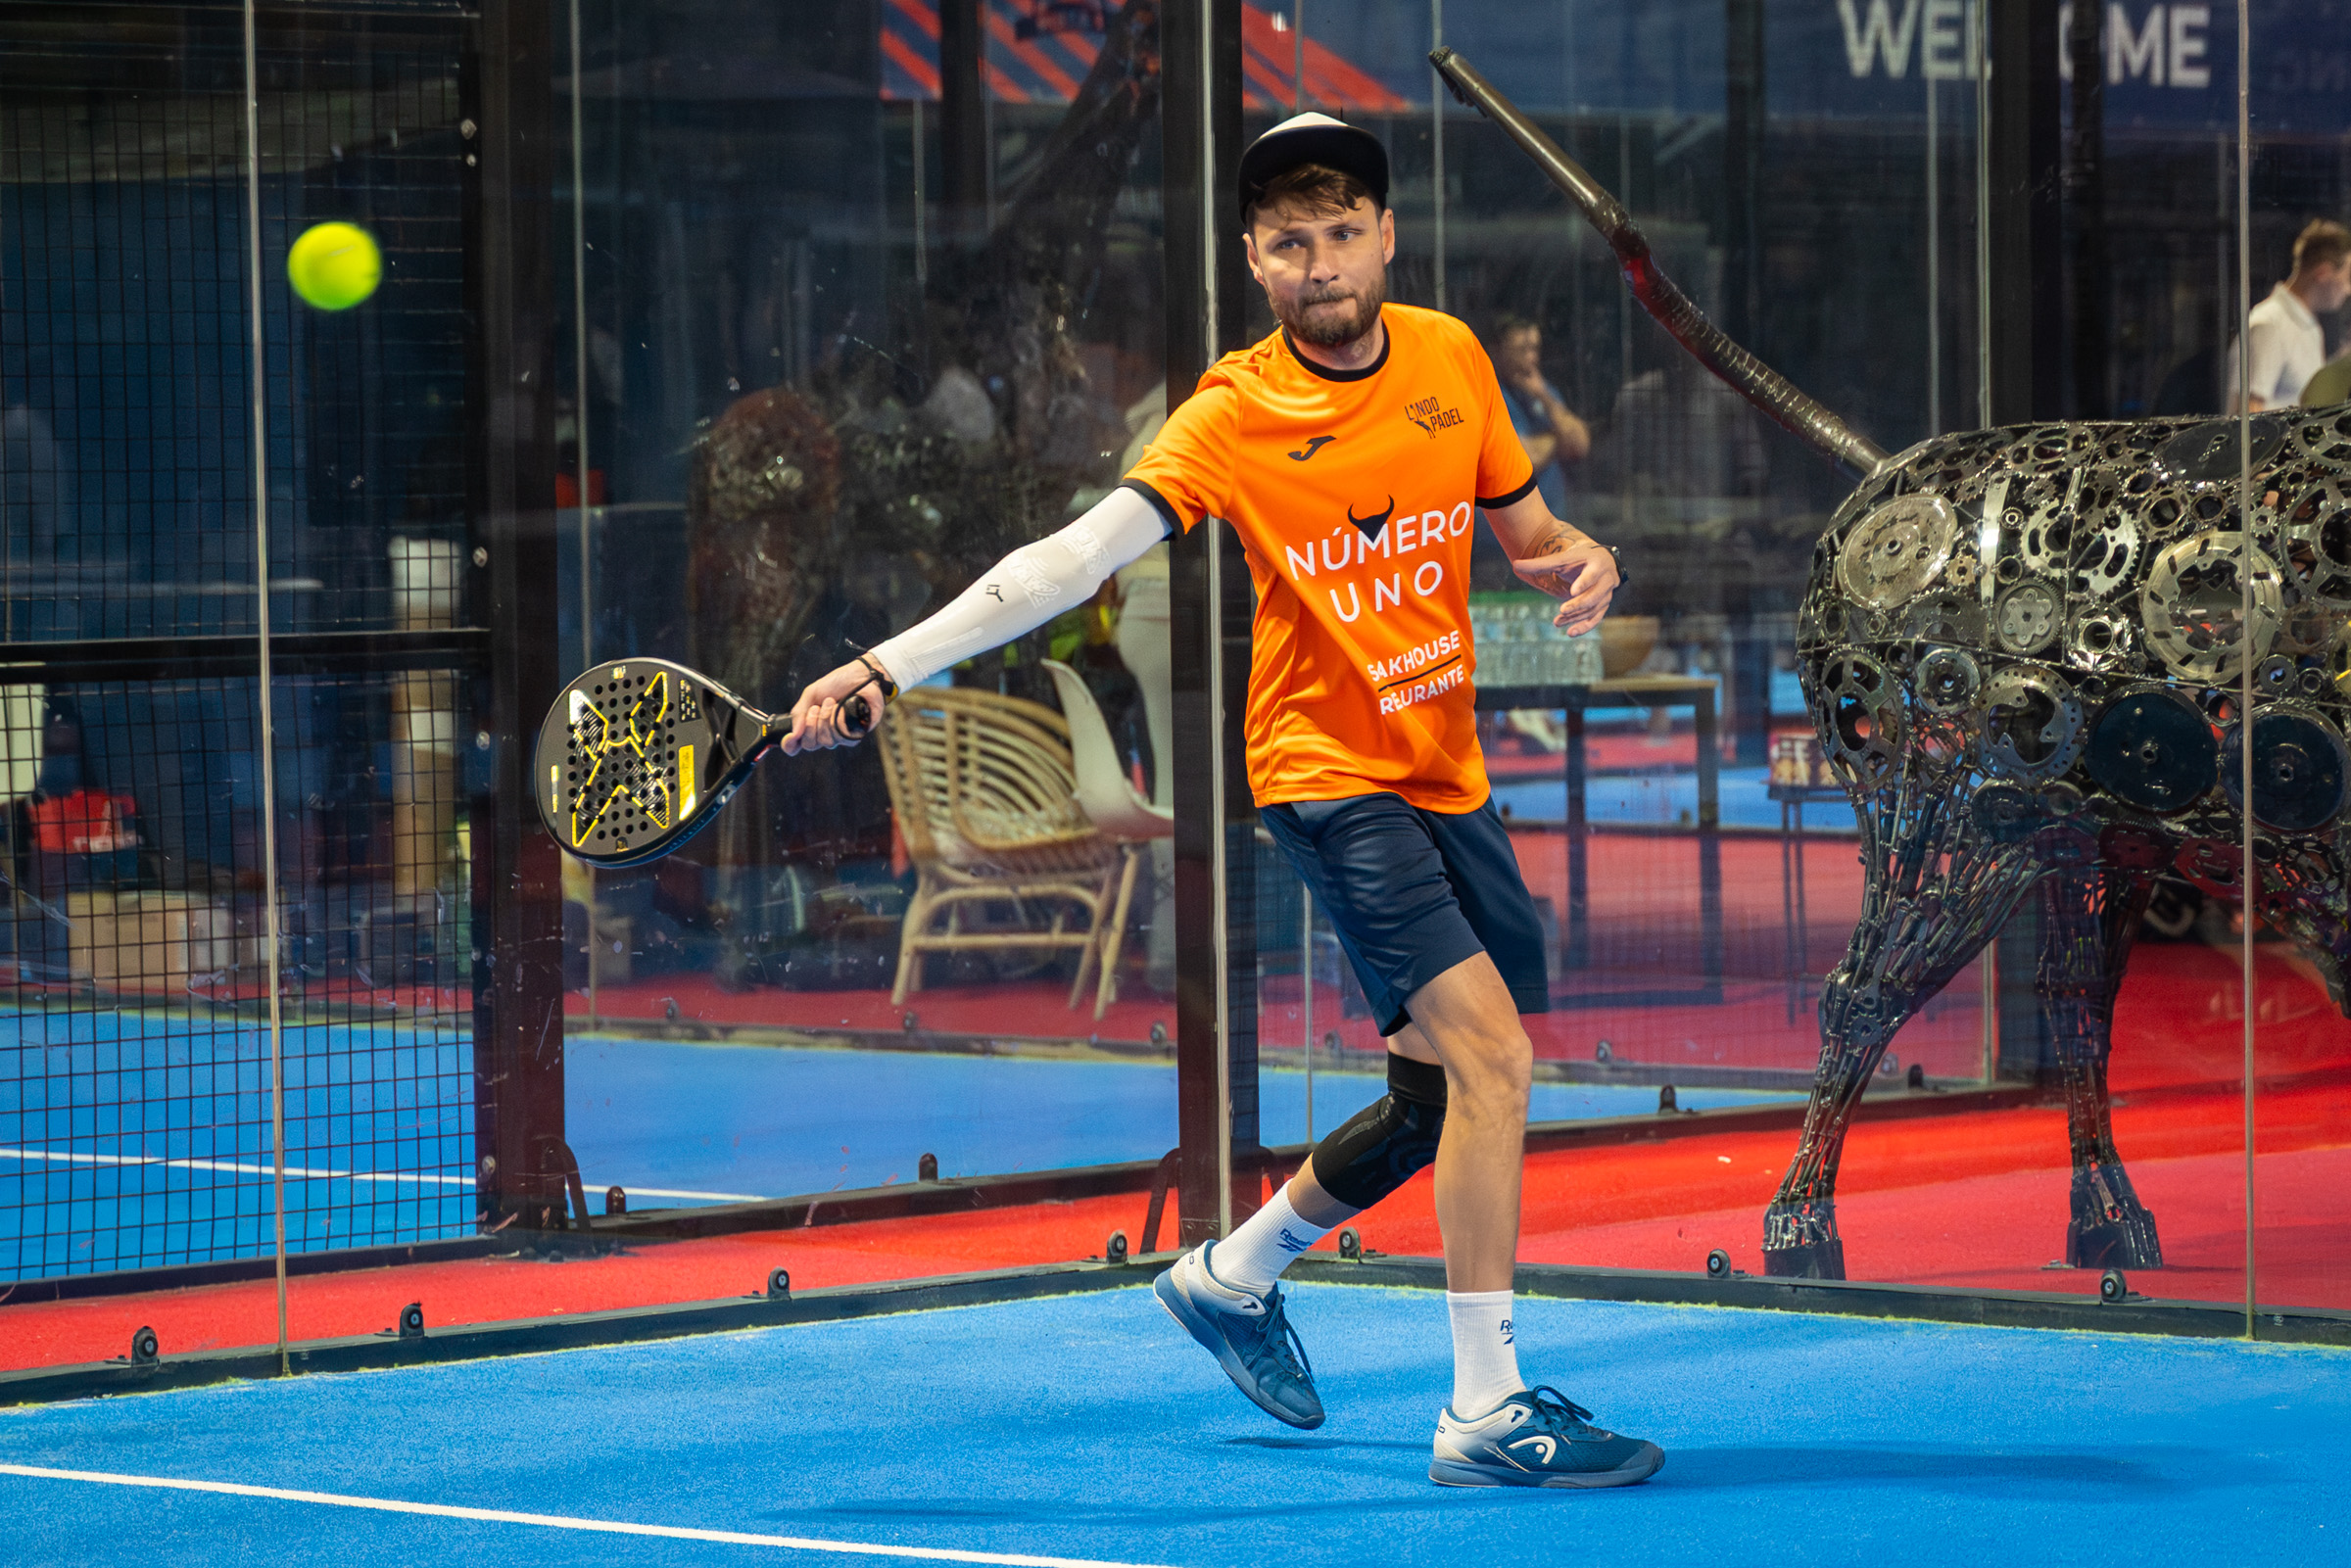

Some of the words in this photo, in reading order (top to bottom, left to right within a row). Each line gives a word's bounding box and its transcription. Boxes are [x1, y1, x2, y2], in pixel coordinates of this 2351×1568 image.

[1838, 0, 2211, 88] WELME
[1429, 407, 1464, 432] PADEL
[1285, 500, 1471, 582] NÚMERO
[1328, 560, 1443, 623] UNO
